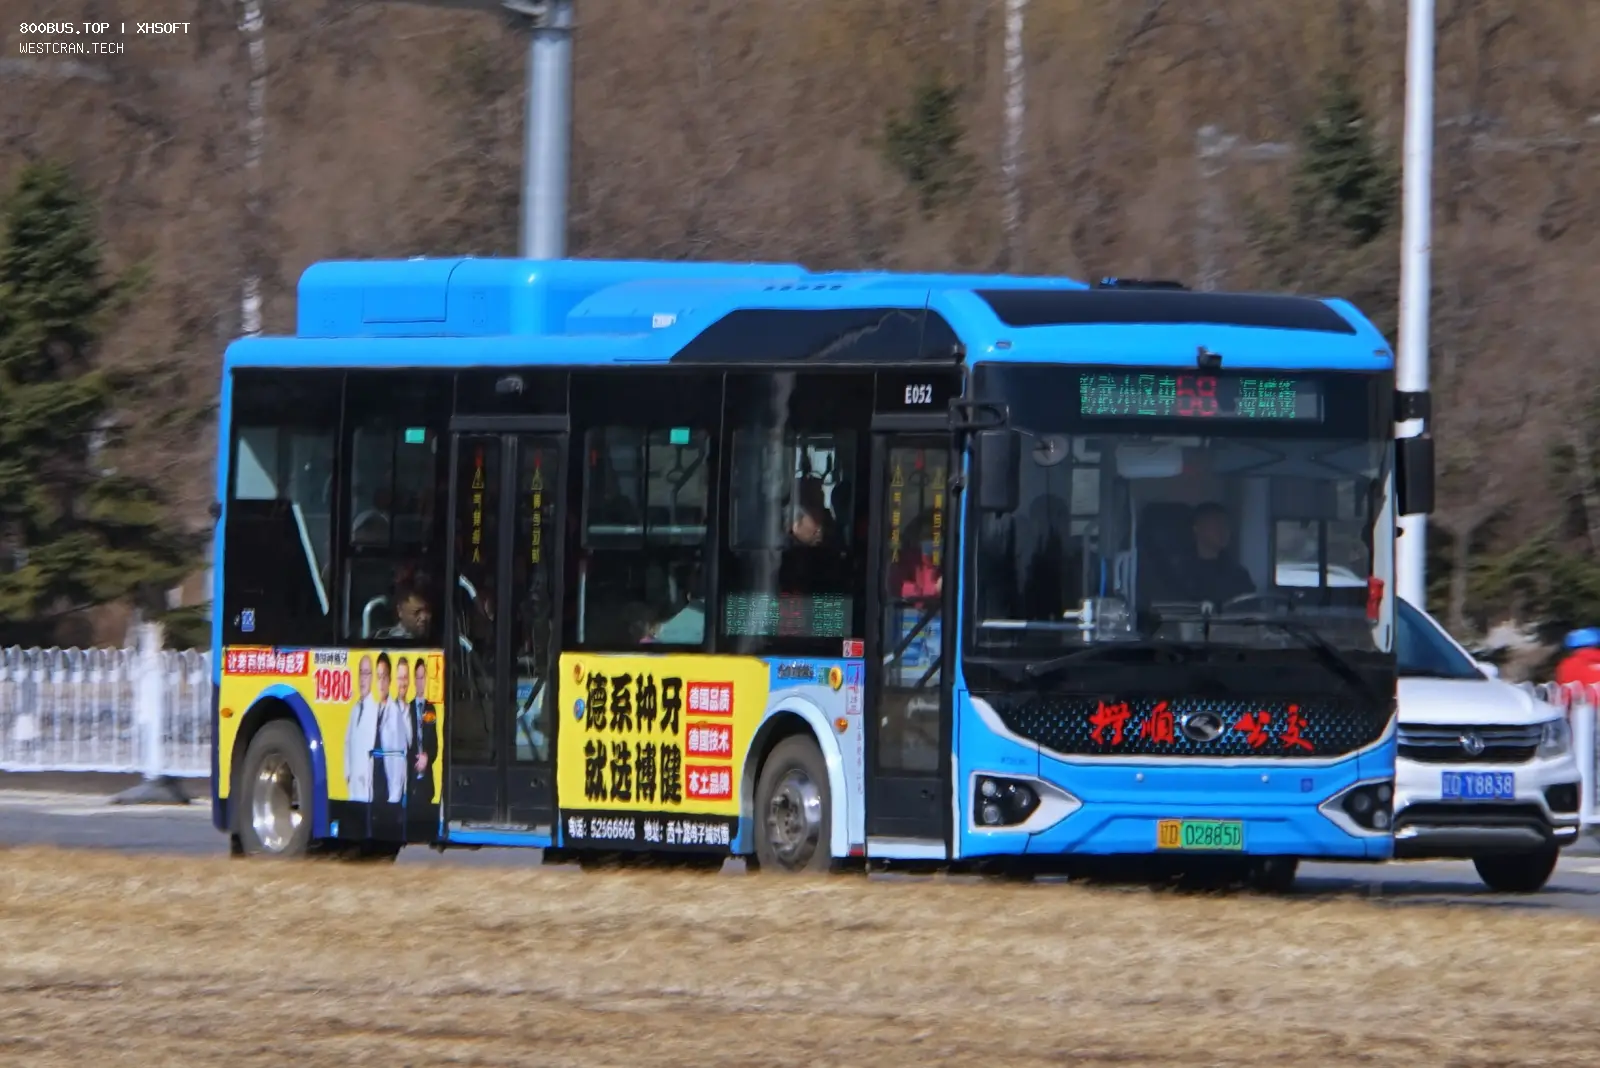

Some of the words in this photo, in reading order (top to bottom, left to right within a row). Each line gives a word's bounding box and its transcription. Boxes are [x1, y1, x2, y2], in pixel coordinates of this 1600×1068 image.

[904, 383, 933, 404] E052
[314, 668, 352, 702] 1980
[585, 671, 683, 735] 德系种牙
[688, 769, 730, 796] 本土品牌
